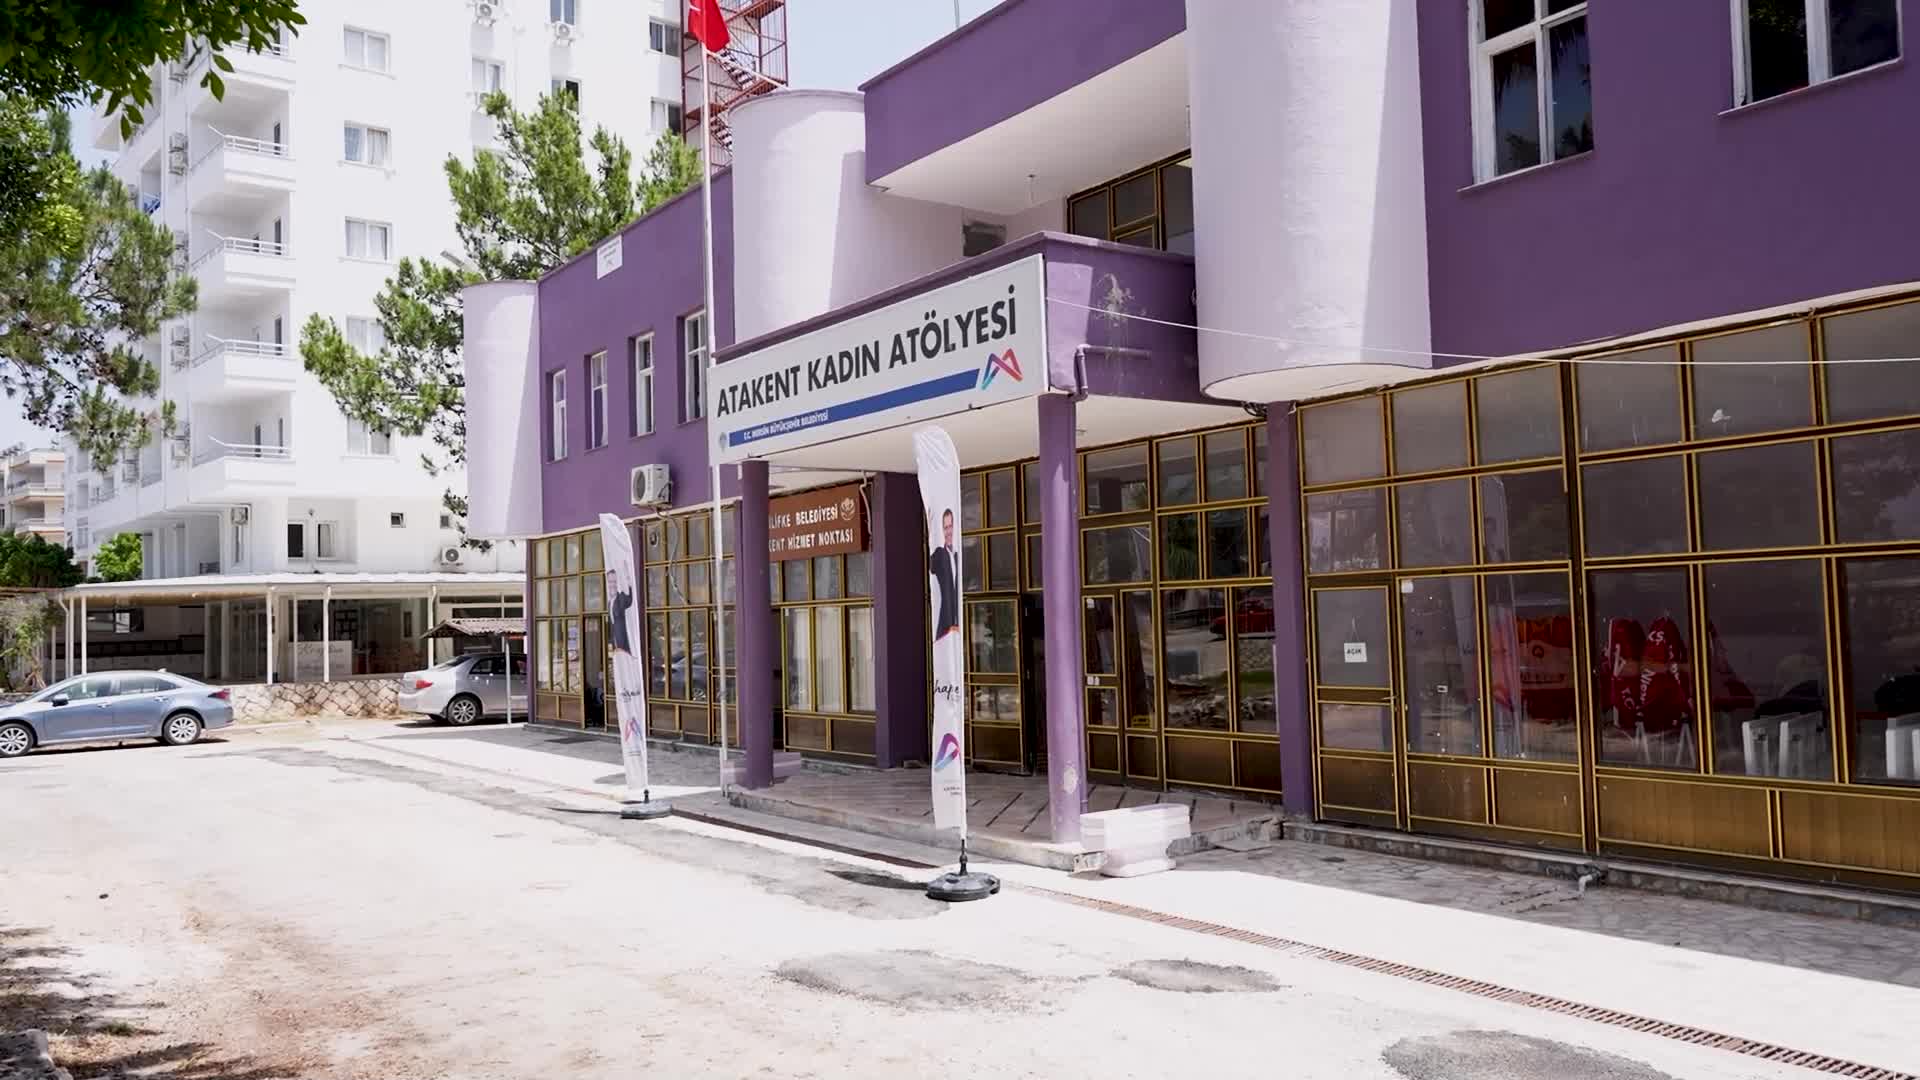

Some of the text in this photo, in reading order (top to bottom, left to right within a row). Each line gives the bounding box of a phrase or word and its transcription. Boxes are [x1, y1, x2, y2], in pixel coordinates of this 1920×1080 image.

[717, 284, 1016, 417] ATAKENT KADIN ATÖLYESİ
[796, 503, 838, 526] BELEDİYESİ
[787, 532, 816, 550] HİZMET
[819, 528, 853, 546] NOKTASI
